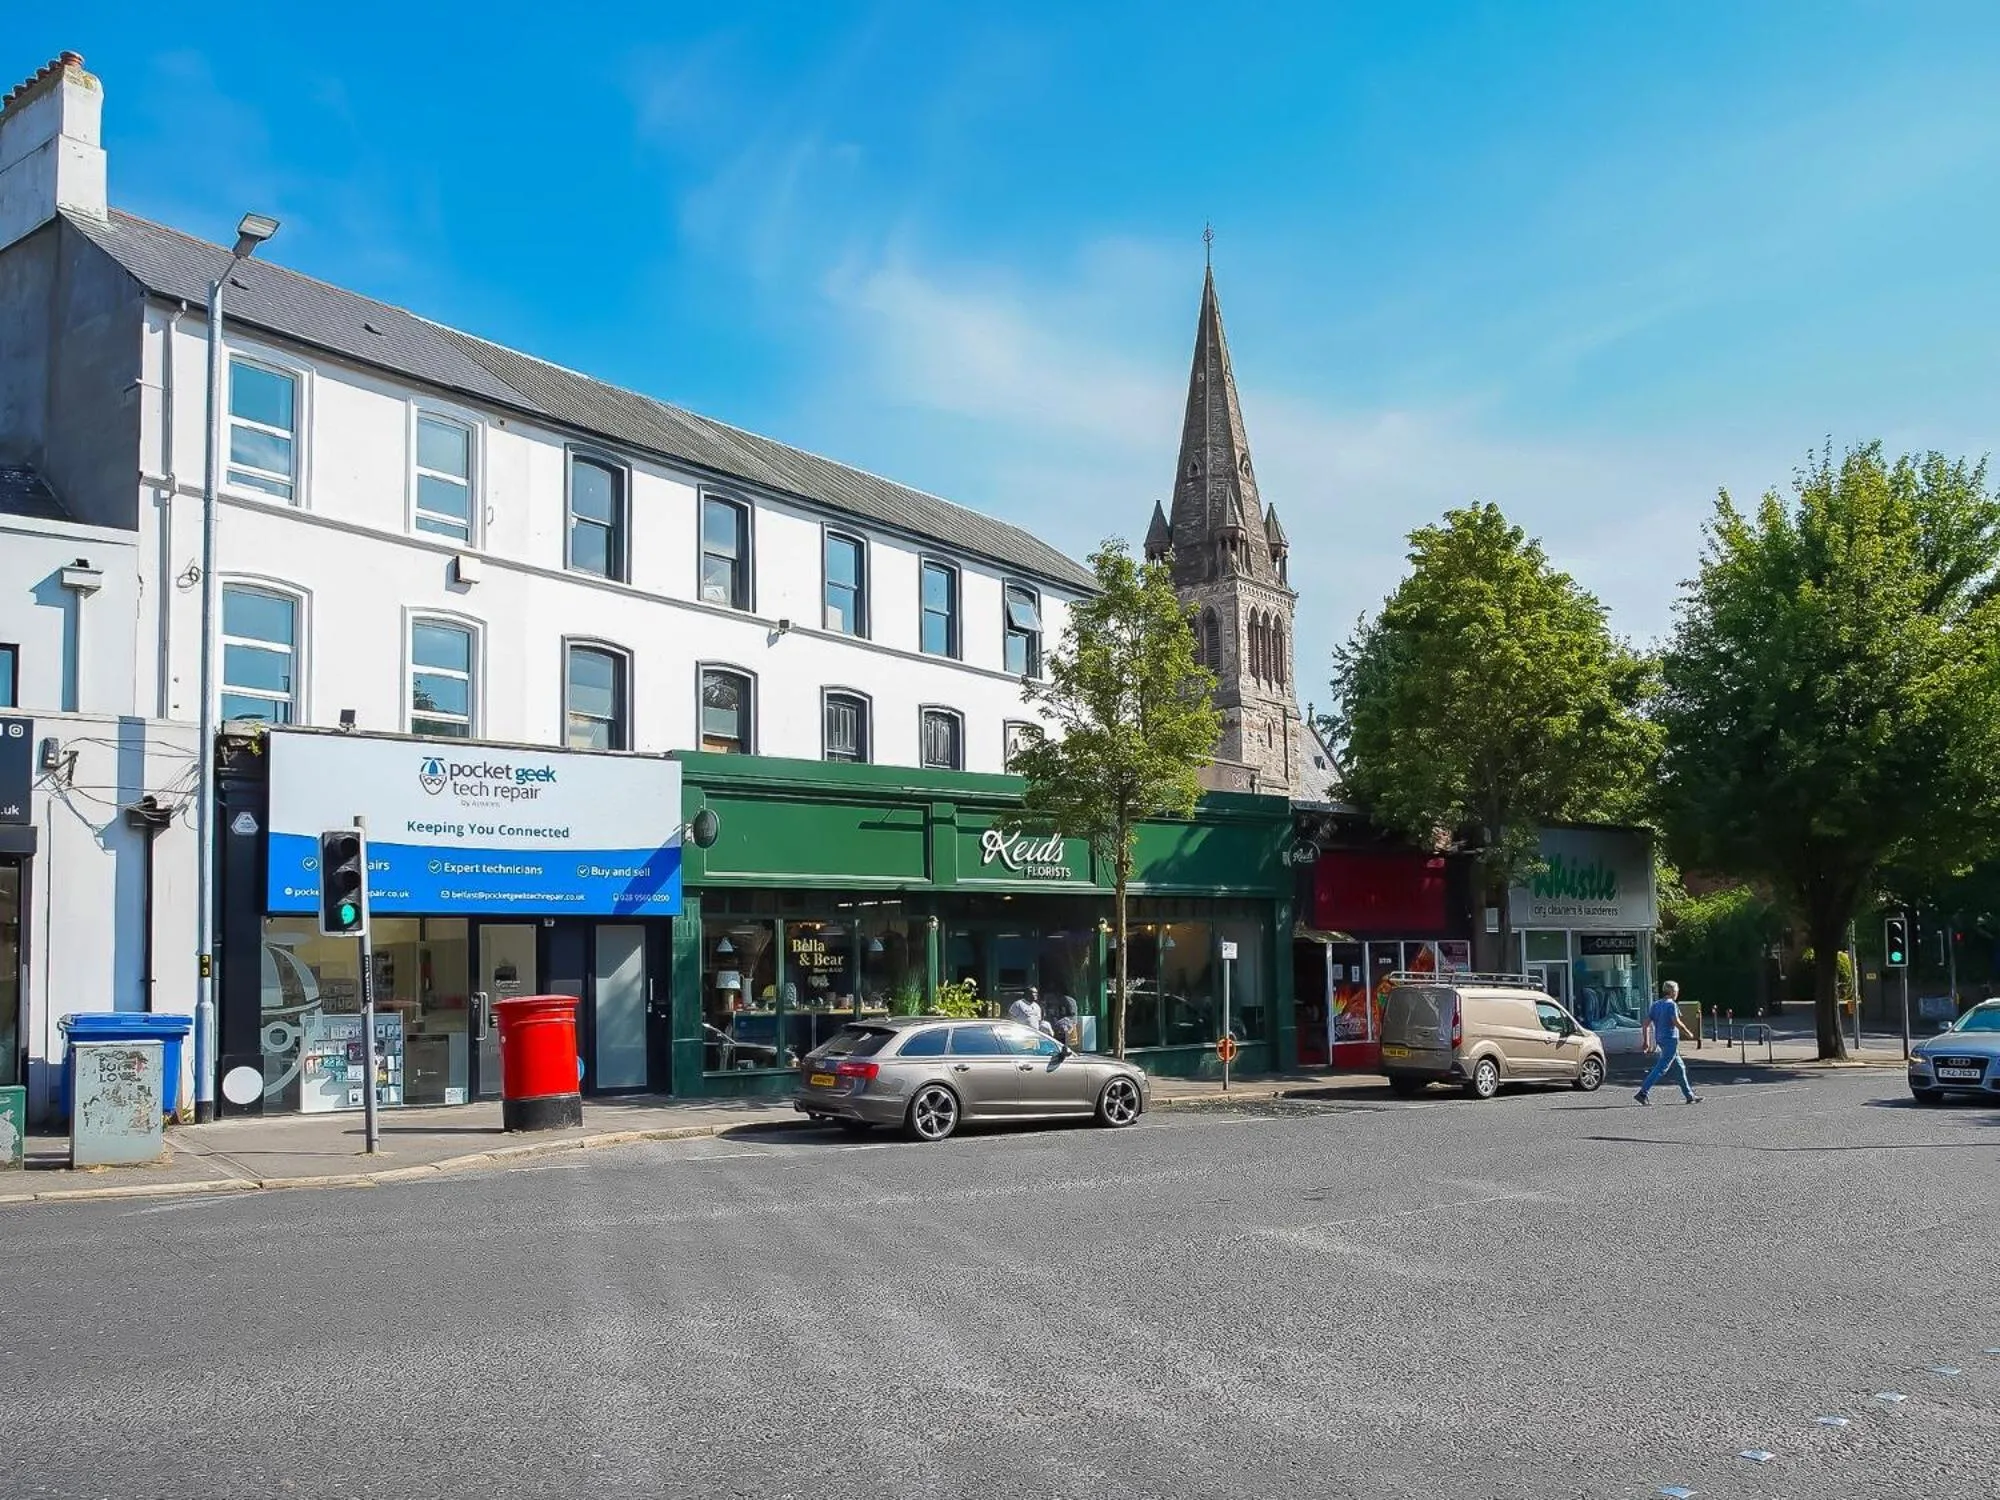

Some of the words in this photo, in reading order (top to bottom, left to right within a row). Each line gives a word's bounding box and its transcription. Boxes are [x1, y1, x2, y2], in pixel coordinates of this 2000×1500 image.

[450, 762, 513, 781] pocket
[515, 765, 557, 785] geek
[453, 781, 489, 797] tech
[494, 784, 541, 803] repair
[407, 821, 465, 837] Keeping
[469, 823, 495, 836] You
[499, 825, 570, 838] Connected
[444, 863, 481, 875] Expert
[482, 864, 544, 875] technicians
[591, 866, 610, 878] Buy
[612, 867, 632, 877] and
[633, 867, 651, 877] sell
[1027, 866, 1072, 877] FLORISTS
[792, 938, 825, 952] Bella
[799, 953, 811, 966] &
[813, 953, 844, 966] Bear
